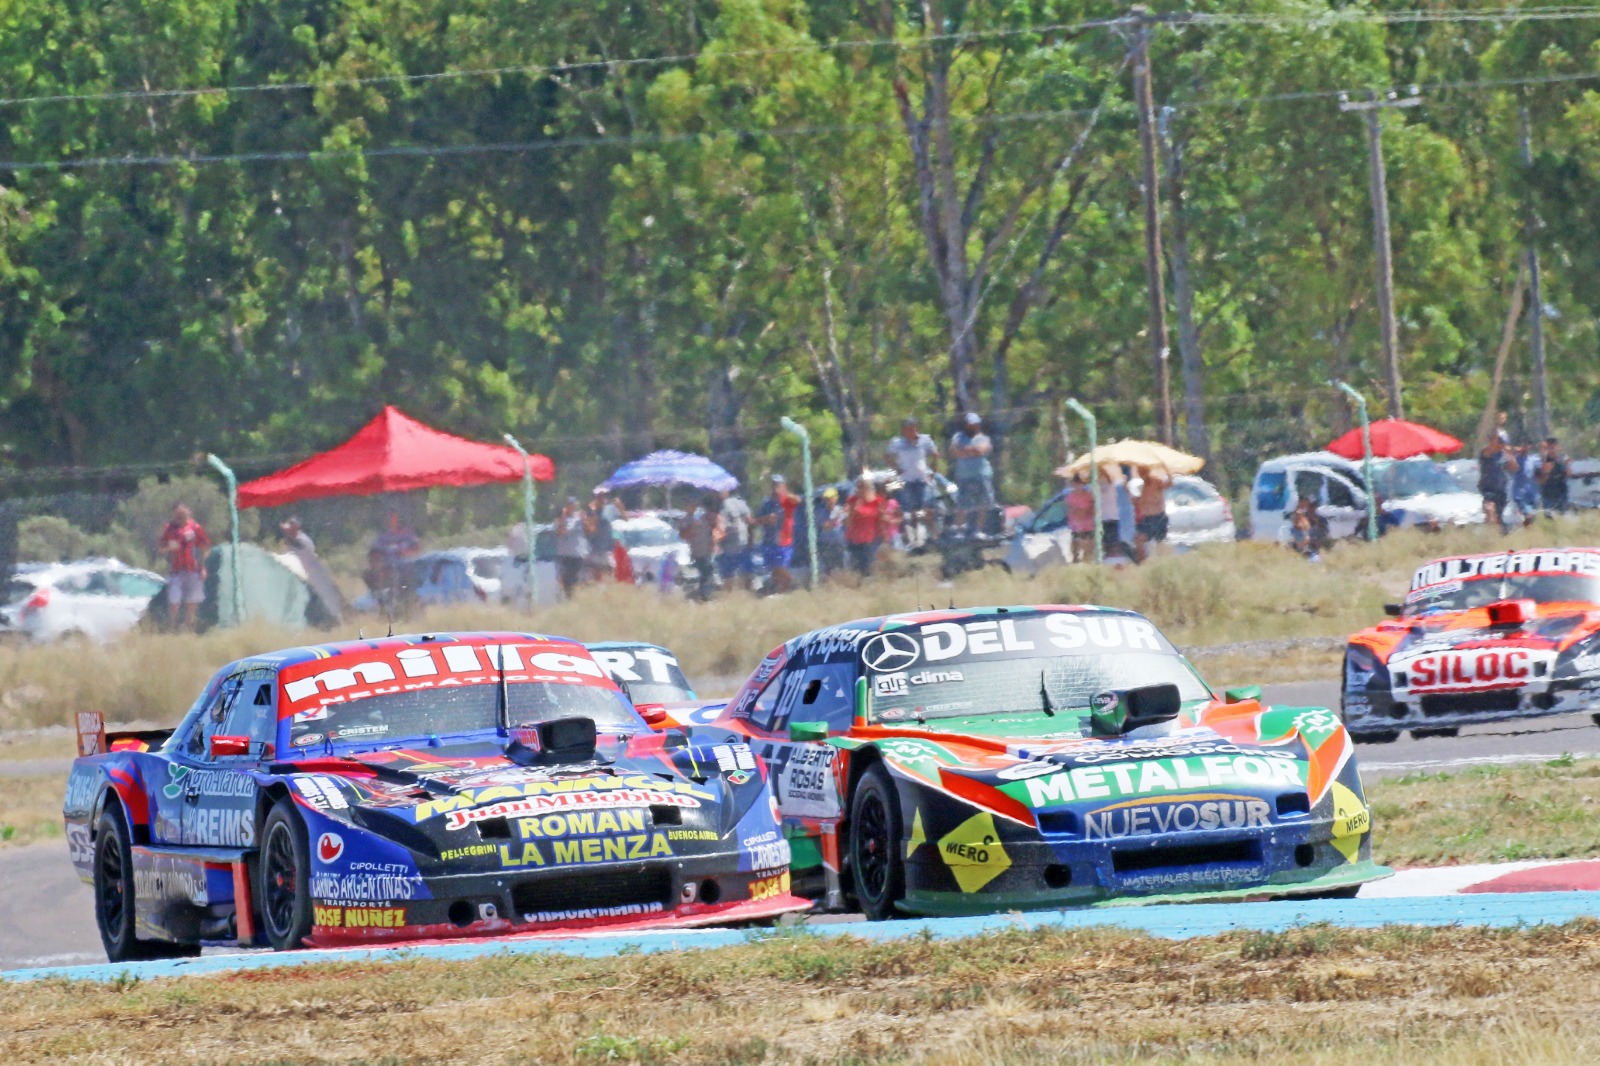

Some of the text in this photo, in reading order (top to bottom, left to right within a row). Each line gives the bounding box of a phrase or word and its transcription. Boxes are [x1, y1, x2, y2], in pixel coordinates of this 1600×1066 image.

[921, 613, 1161, 661] DEL SUR
[284, 643, 604, 703] milla
[910, 671, 964, 685] clima
[1411, 651, 1528, 687] SILOC
[338, 725, 389, 737] CRISTEM
[790, 748, 835, 768] ALBERTO
[789, 769, 825, 790] ROSAS
[1025, 755, 1305, 807] METALFOR
[416, 776, 715, 822] MANNOL
[196, 808, 255, 847] REIMS
[518, 810, 645, 839] ROMAN
[1085, 801, 1273, 840] NUEVOSUR
[1347, 812, 1368, 834] MERO
[668, 830, 719, 841] BUENOS AIRES
[441, 844, 497, 861] PELLEGRINI
[500, 833, 674, 867] LA MENZA
[946, 842, 989, 863] MERO
[350, 862, 408, 873] CIPOLLETTI
[1122, 872, 1190, 887] MATERIALES
[323, 899, 391, 907] TRANSPORTE
